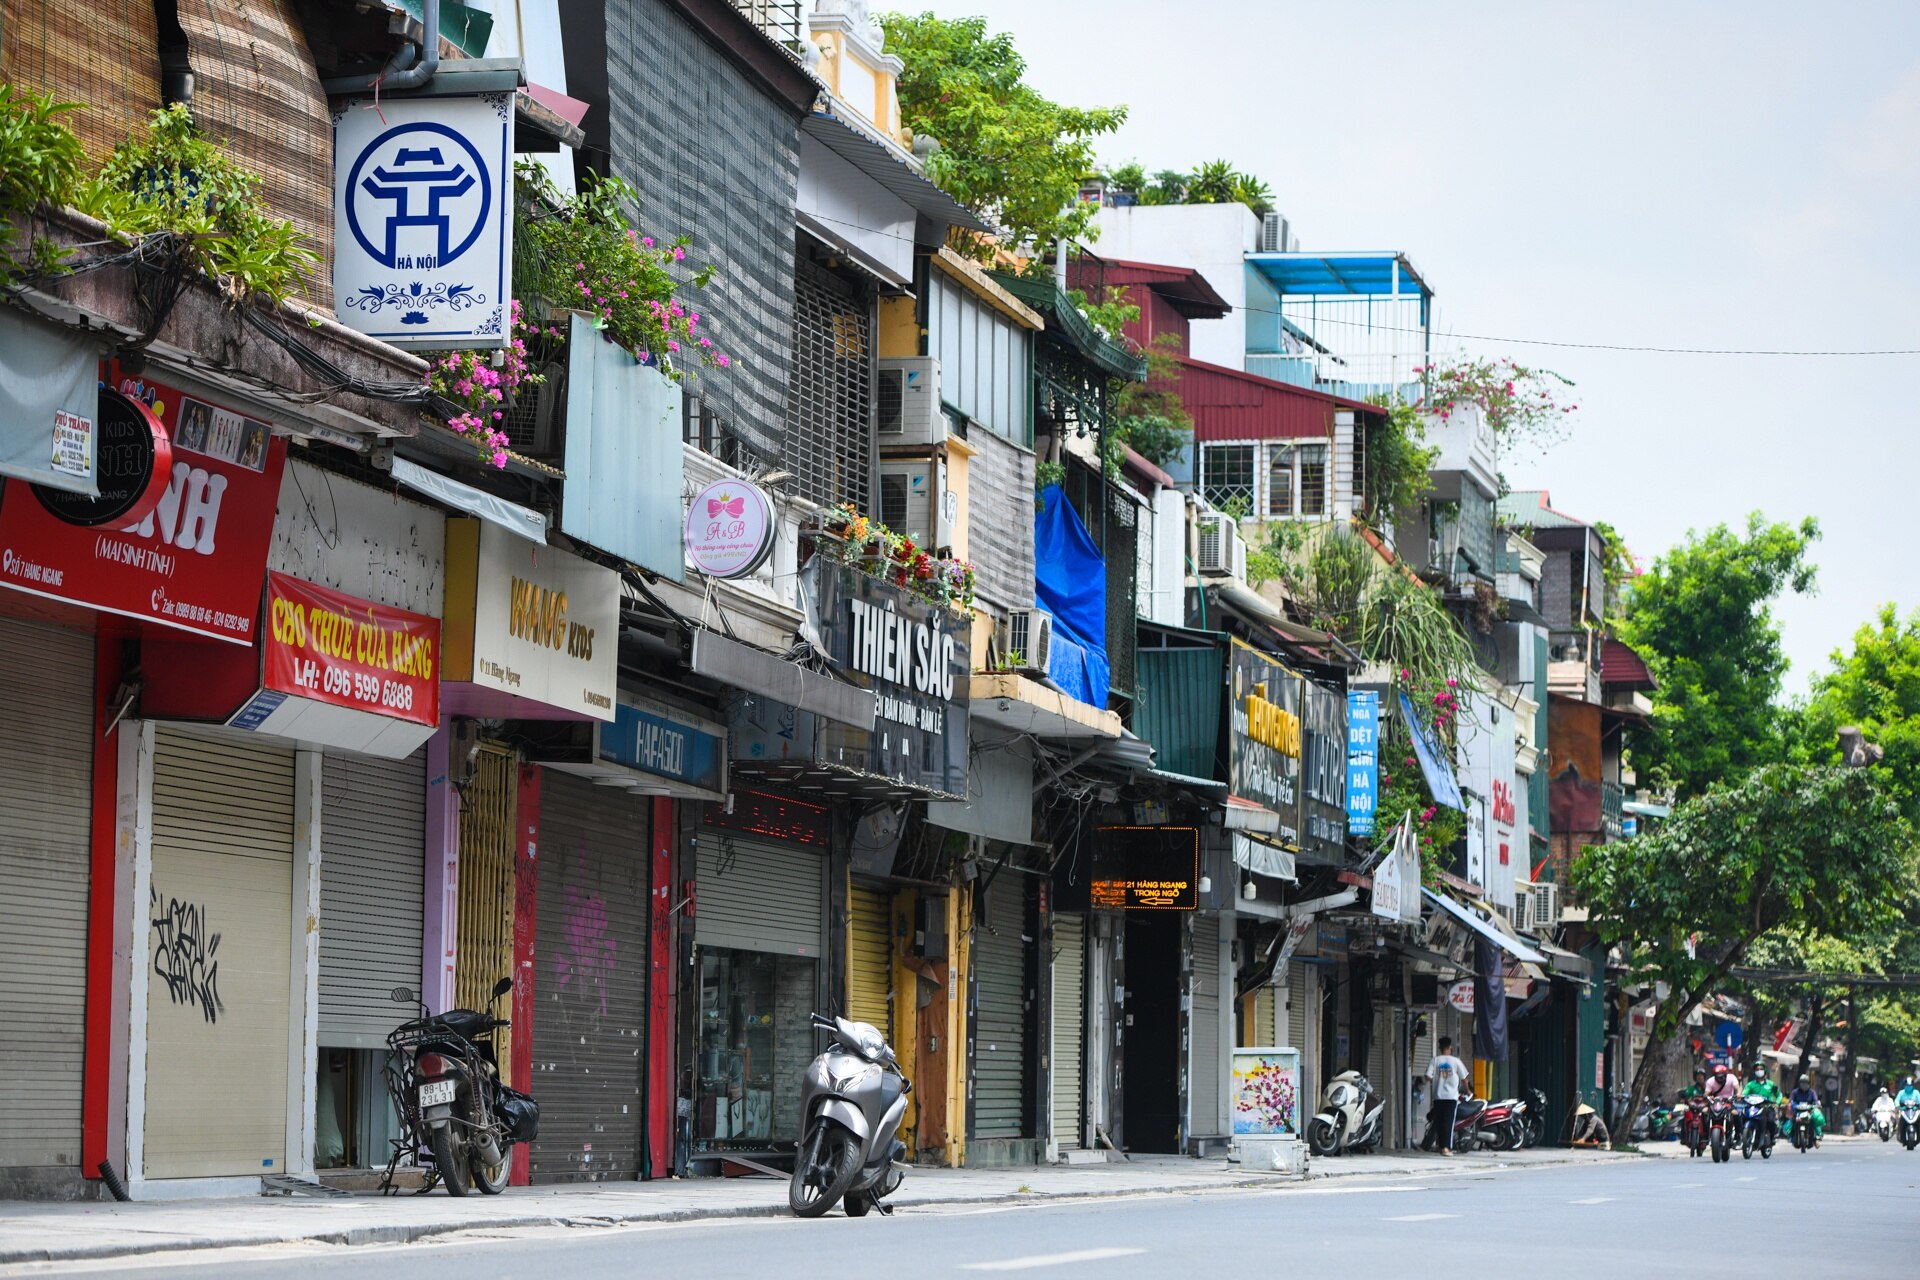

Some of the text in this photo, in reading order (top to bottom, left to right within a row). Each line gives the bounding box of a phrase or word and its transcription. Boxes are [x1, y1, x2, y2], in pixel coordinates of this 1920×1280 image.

[397, 254, 437, 272] HÀ NỘI
[106, 421, 135, 438] KIDS
[121, 543, 146, 569] SINH
[20, 561, 25, 577] 7
[24, 560, 41, 581] HÀNG
[41, 566, 63, 586] NGANG
[510, 575, 595, 661] WANG KIDS
[272, 597, 432, 680] CHO THUÊ CỬA HÀNG
[851, 598, 955, 700] THIÊN SẮC
[485, 659, 491, 675] 11
[505, 666, 521, 687] Ngang
[294, 657, 413, 711] LH: 096 599 6888
[884, 694, 898, 722] BÁN
[920, 706, 933, 733] BÁN
[1352, 708, 1370, 719] NGA
[1350, 726, 1372, 746] DỆT
[1350, 750, 1373, 766] KIM
[1353, 771, 1369, 788] HÀ
[1351, 793, 1372, 813] NỘI
[1126, 881, 1135, 889] 21
[1137, 879, 1158, 889] HÀNG
[1160, 881, 1187, 889] NGANG
[1134, 889, 1160, 897] TRONG
[424, 1082, 449, 1095] 89-L1
